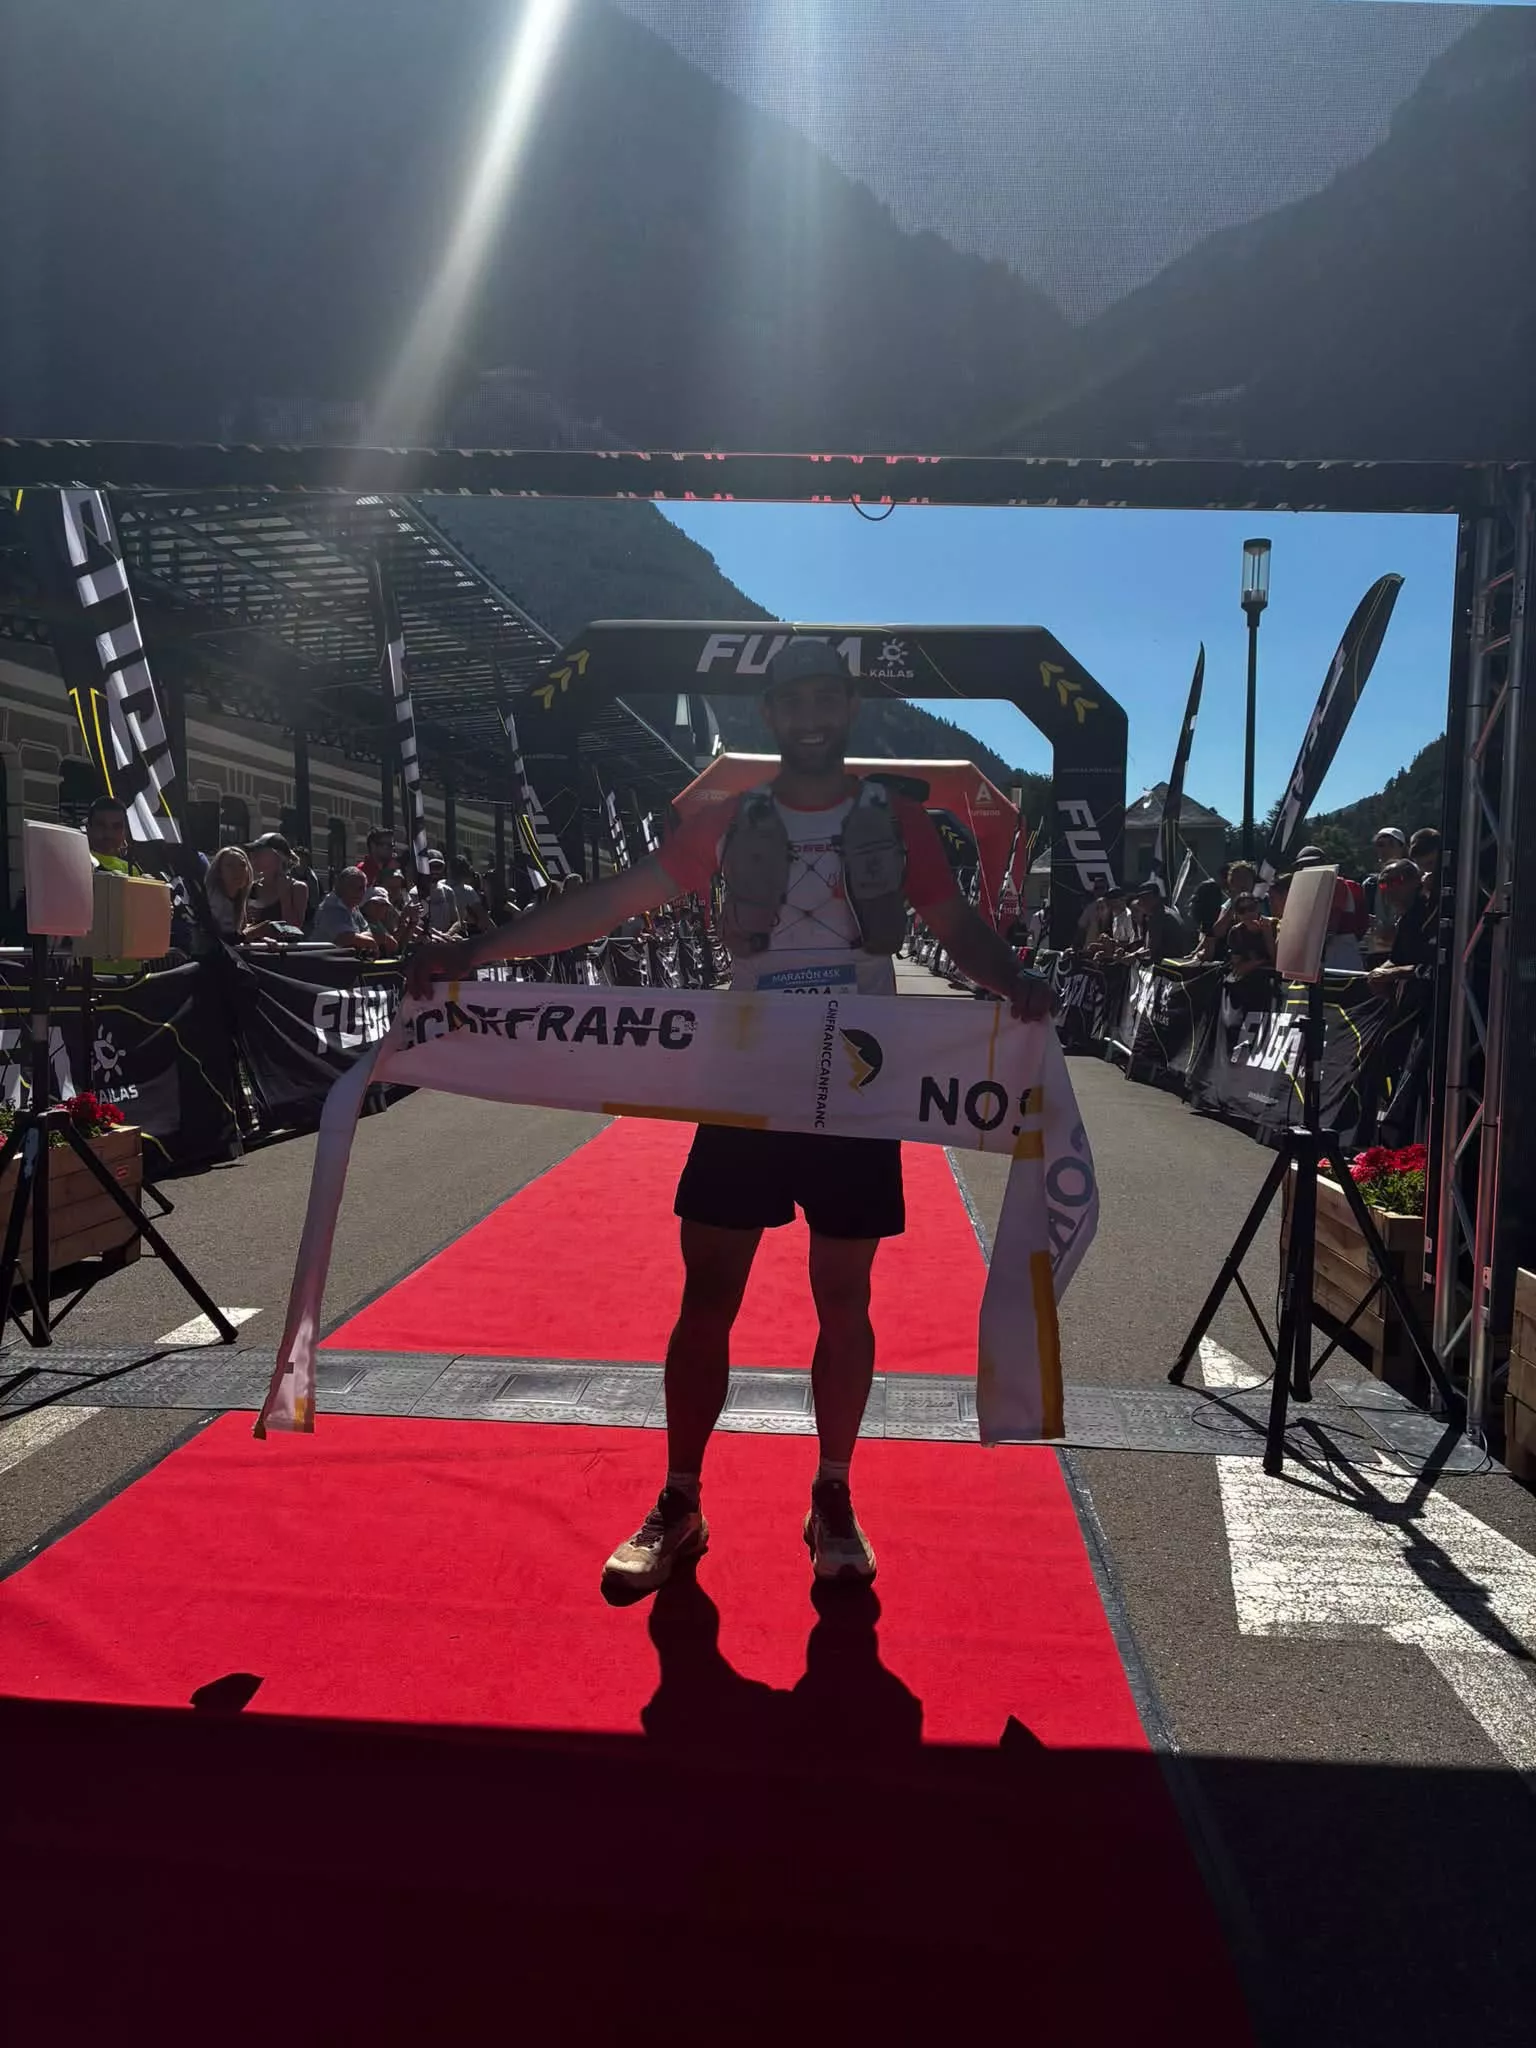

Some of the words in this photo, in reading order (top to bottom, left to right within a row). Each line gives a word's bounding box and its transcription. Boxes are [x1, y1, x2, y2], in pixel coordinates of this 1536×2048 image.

[696, 633, 863, 677] FUA
[869, 668, 915, 679] KAILAS
[1056, 799, 1117, 892] FUG
[96, 1084, 139, 1104] AILAS
